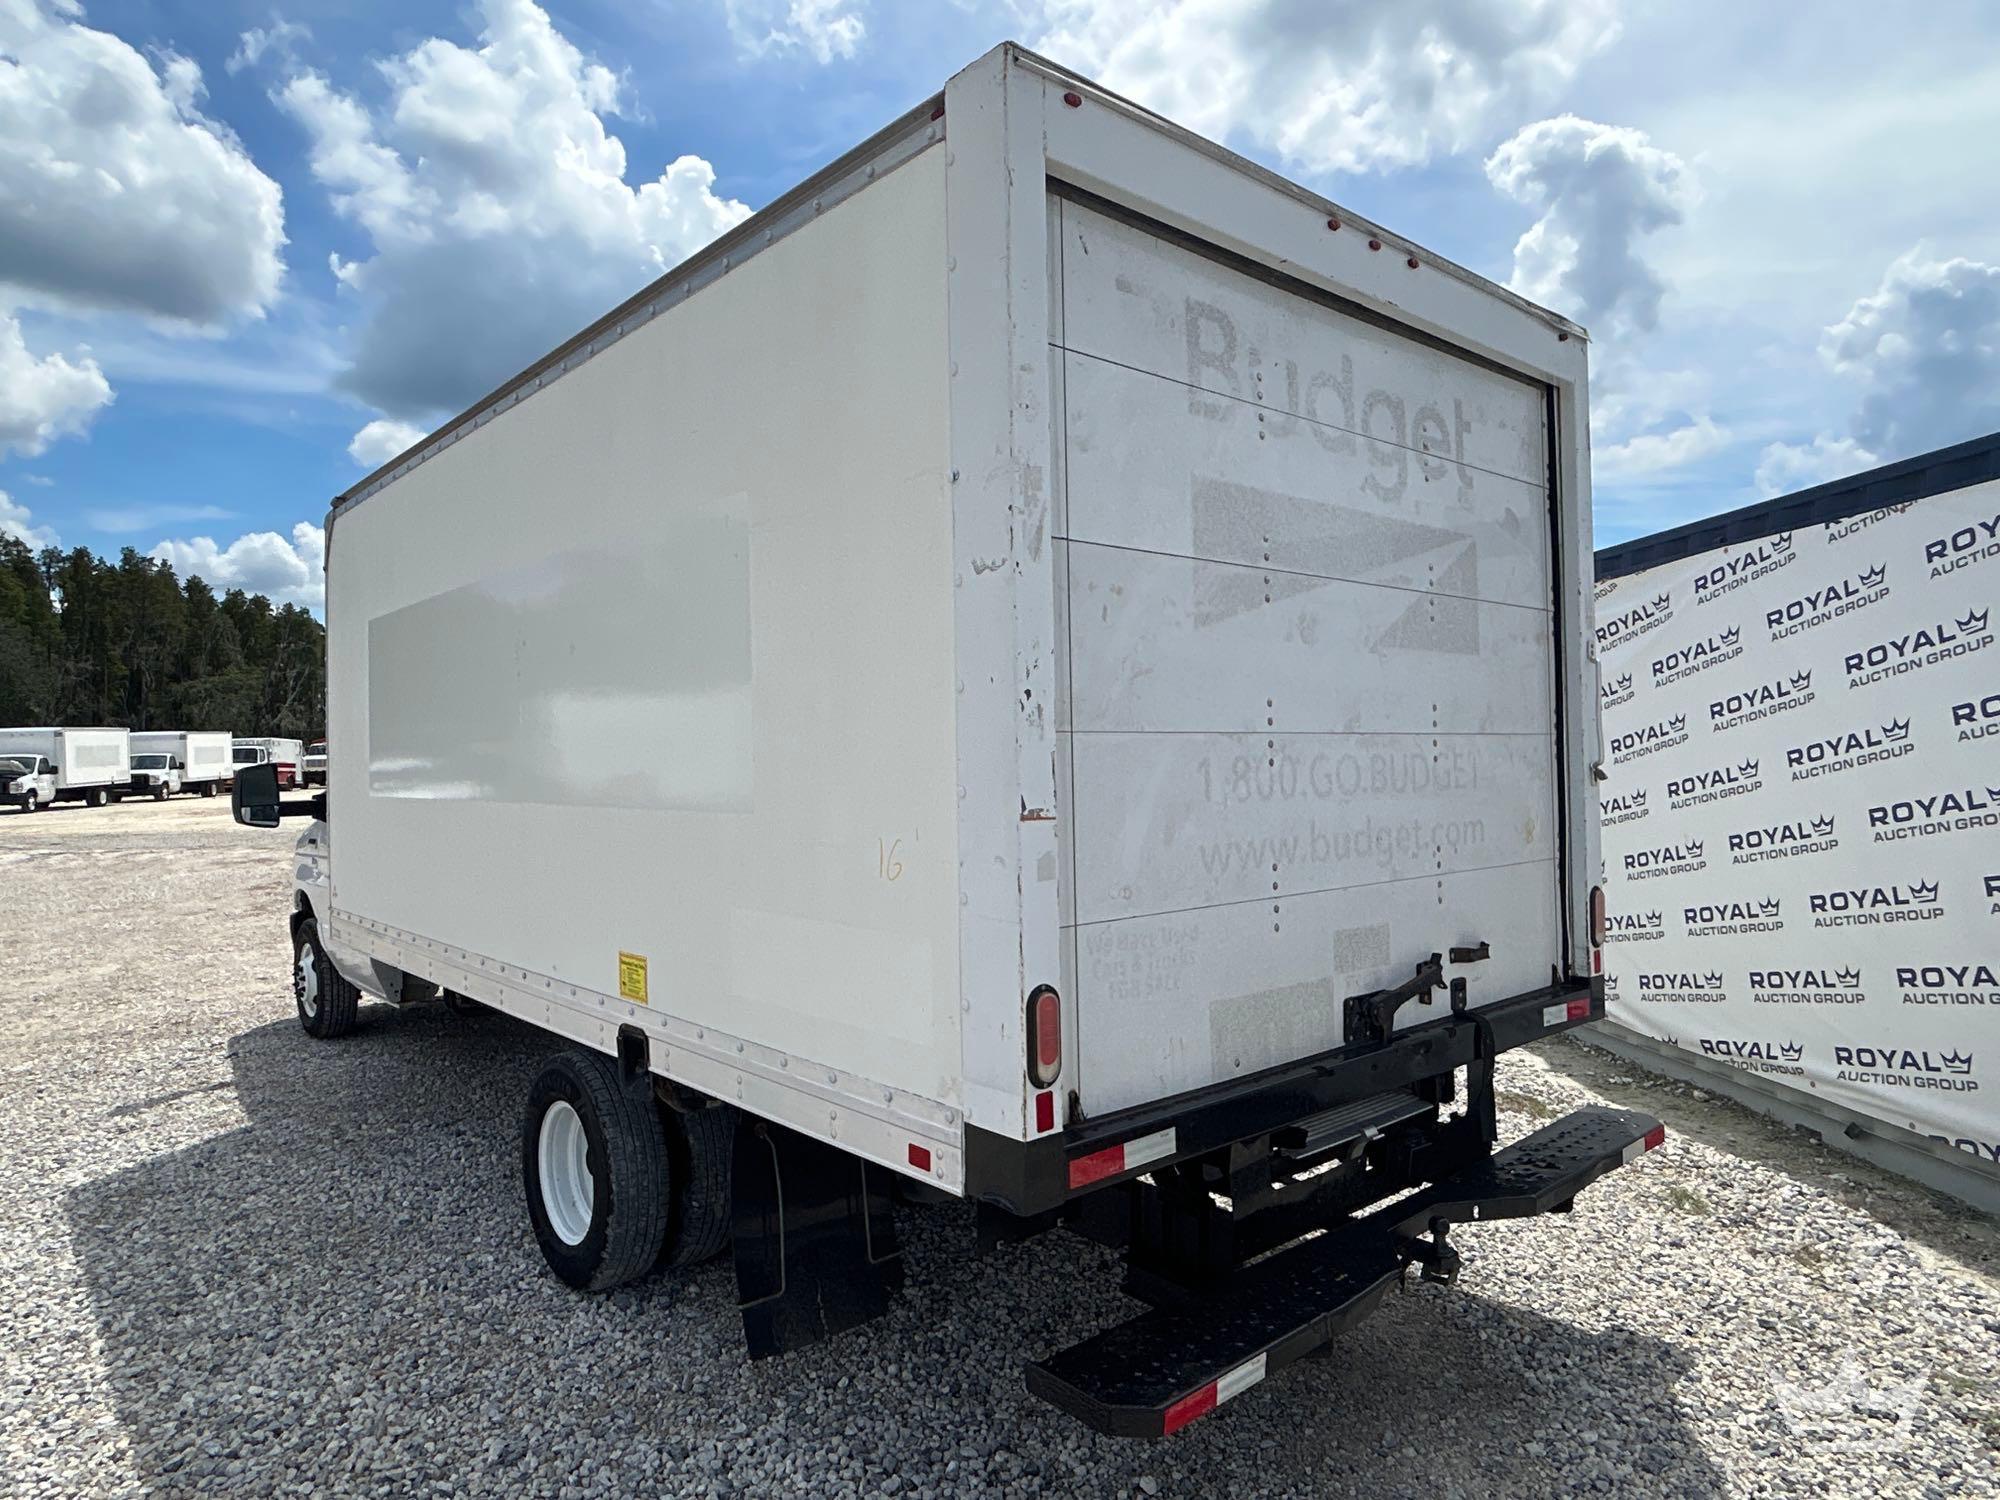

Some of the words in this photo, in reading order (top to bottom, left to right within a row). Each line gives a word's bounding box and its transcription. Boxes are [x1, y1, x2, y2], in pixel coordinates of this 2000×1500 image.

[1925, 514, 2000, 564] ROY
[1694, 547, 1772, 594] ROYAL
[1930, 542, 2000, 580] AUCTIO
[1594, 582, 1618, 601] ROUP
[1697, 575, 1748, 606] AUCTION
[1751, 552, 1796, 580] GROUP
[1766, 579, 1859, 629] ROYAL
[1771, 609, 1832, 642] AUCTION
[1834, 586, 1890, 617] GROUP
[1595, 605, 1655, 643] ROYAL
[1600, 629, 1639, 653] AUCTION
[1640, 611, 1674, 634] GROUP
[1652, 637, 1721, 677] ROYAL
[1845, 624, 1957, 674] ROYAL
[1849, 657, 1923, 690] AUCTION
[1926, 634, 1994, 665] GROUP
[1655, 664, 1700, 688] AUCTION
[1702, 646, 1744, 670] GROUP
[1709, 680, 1791, 720] ROYAL
[1713, 705, 1766, 733] AUCTION
[1768, 692, 1816, 719] GROUP
[1610, 723, 1669, 754] ROYAL
[1613, 746, 1653, 765] AUCTION
[1653, 733, 1689, 752] GROUP
[1786, 729, 1882, 767] ROYAL
[1791, 758, 1854, 781] AUCTION
[1857, 743, 1915, 766] GROUP
[1667, 766, 1740, 798] ROYAL
[1670, 791, 1718, 810] AUCTION
[1719, 781, 1762, 800] GROUP
[1600, 796, 1632, 815] YAL
[1617, 808, 1649, 824] GROUP
[1868, 790, 1987, 827] ROYAL
[1728, 822, 1812, 851] ROYAL
[1873, 821, 1951, 843] AUCTION
[1955, 813, 2000, 830] GRO
[1624, 846, 1686, 869] ROYAL
[1732, 849, 1788, 865] AUCTION
[1790, 839, 1839, 858] GROUP
[1627, 867, 1669, 881] AUCTION
[1670, 861, 1707, 875] GROUP
[1684, 902, 1759, 924] ROYAL
[1809, 886, 1910, 912] ROYAL
[1605, 914, 1647, 931] OYAL
[1687, 925, 1737, 937] AUCTION
[1739, 921, 1784, 934] GROUP
[1814, 913, 1880, 928] AUCTION
[1883, 907, 1944, 923] GROUP
[1604, 934, 1631, 943] CTION
[1632, 931, 1665, 942] GROUP
[1639, 974, 1704, 990] ROYAL
[1749, 969, 1837, 989] ROYAL
[1897, 966, 2000, 988] ROYA
[1641, 993, 1686, 1003] AUCTION
[1687, 993, 1726, 1003] GROUP
[1753, 993, 1811, 1004] AUCTION
[1815, 993, 1865, 1004] GROUP
[1902, 993, 1985, 1005] AUCTION
[1700, 1039, 1778, 1060] ROYAL
[1834, 1046, 1941, 1072] ROYAL
[1760, 1062, 1804, 1076] GROUP
[1837, 1070, 1910, 1087] AUCTION
[1914, 1076, 1979, 1092] GROUP
